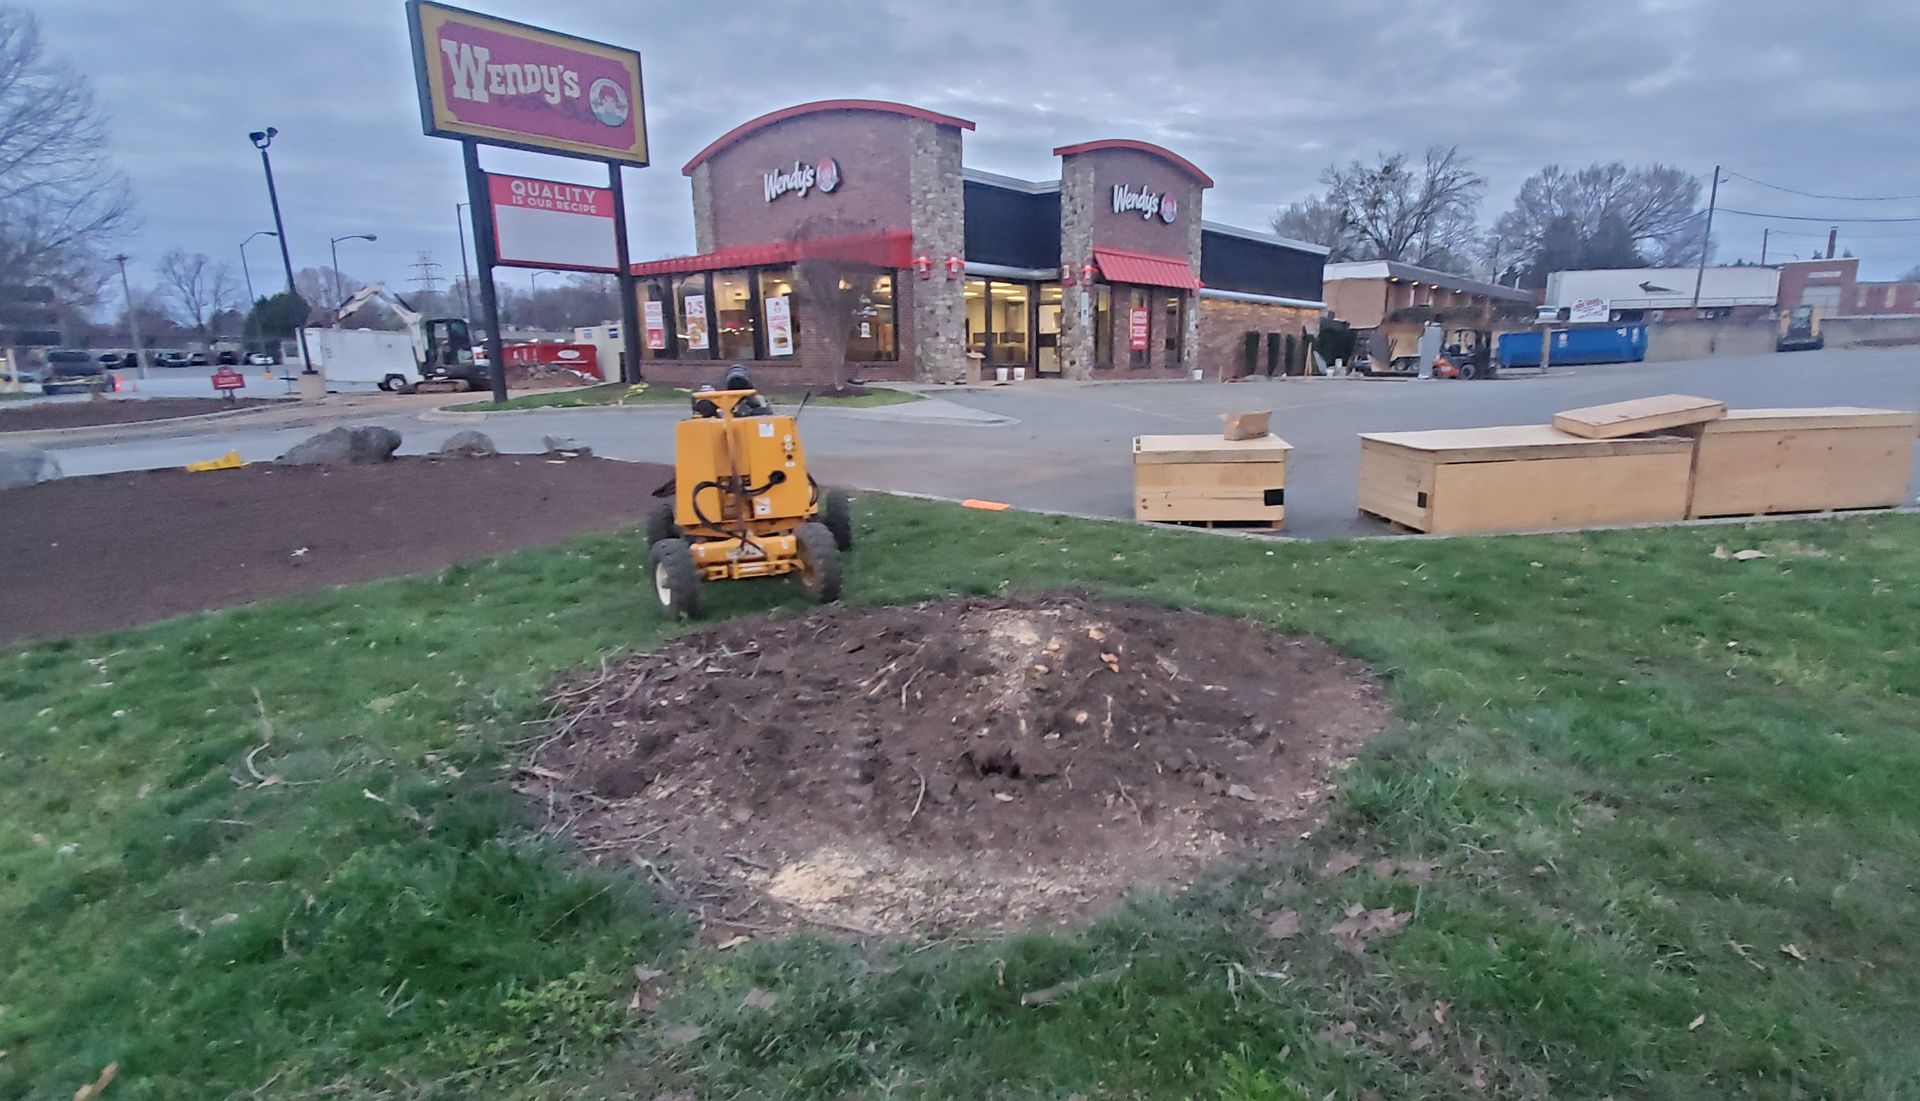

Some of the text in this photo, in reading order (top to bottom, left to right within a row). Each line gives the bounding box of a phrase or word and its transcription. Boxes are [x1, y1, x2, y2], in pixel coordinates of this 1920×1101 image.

[510, 180, 596, 204] QUALITY
[763, 160, 815, 203] Wendy's
[512, 195, 597, 214] IS OUR RECIPE
[1113, 184, 1159, 220] Wendy's
